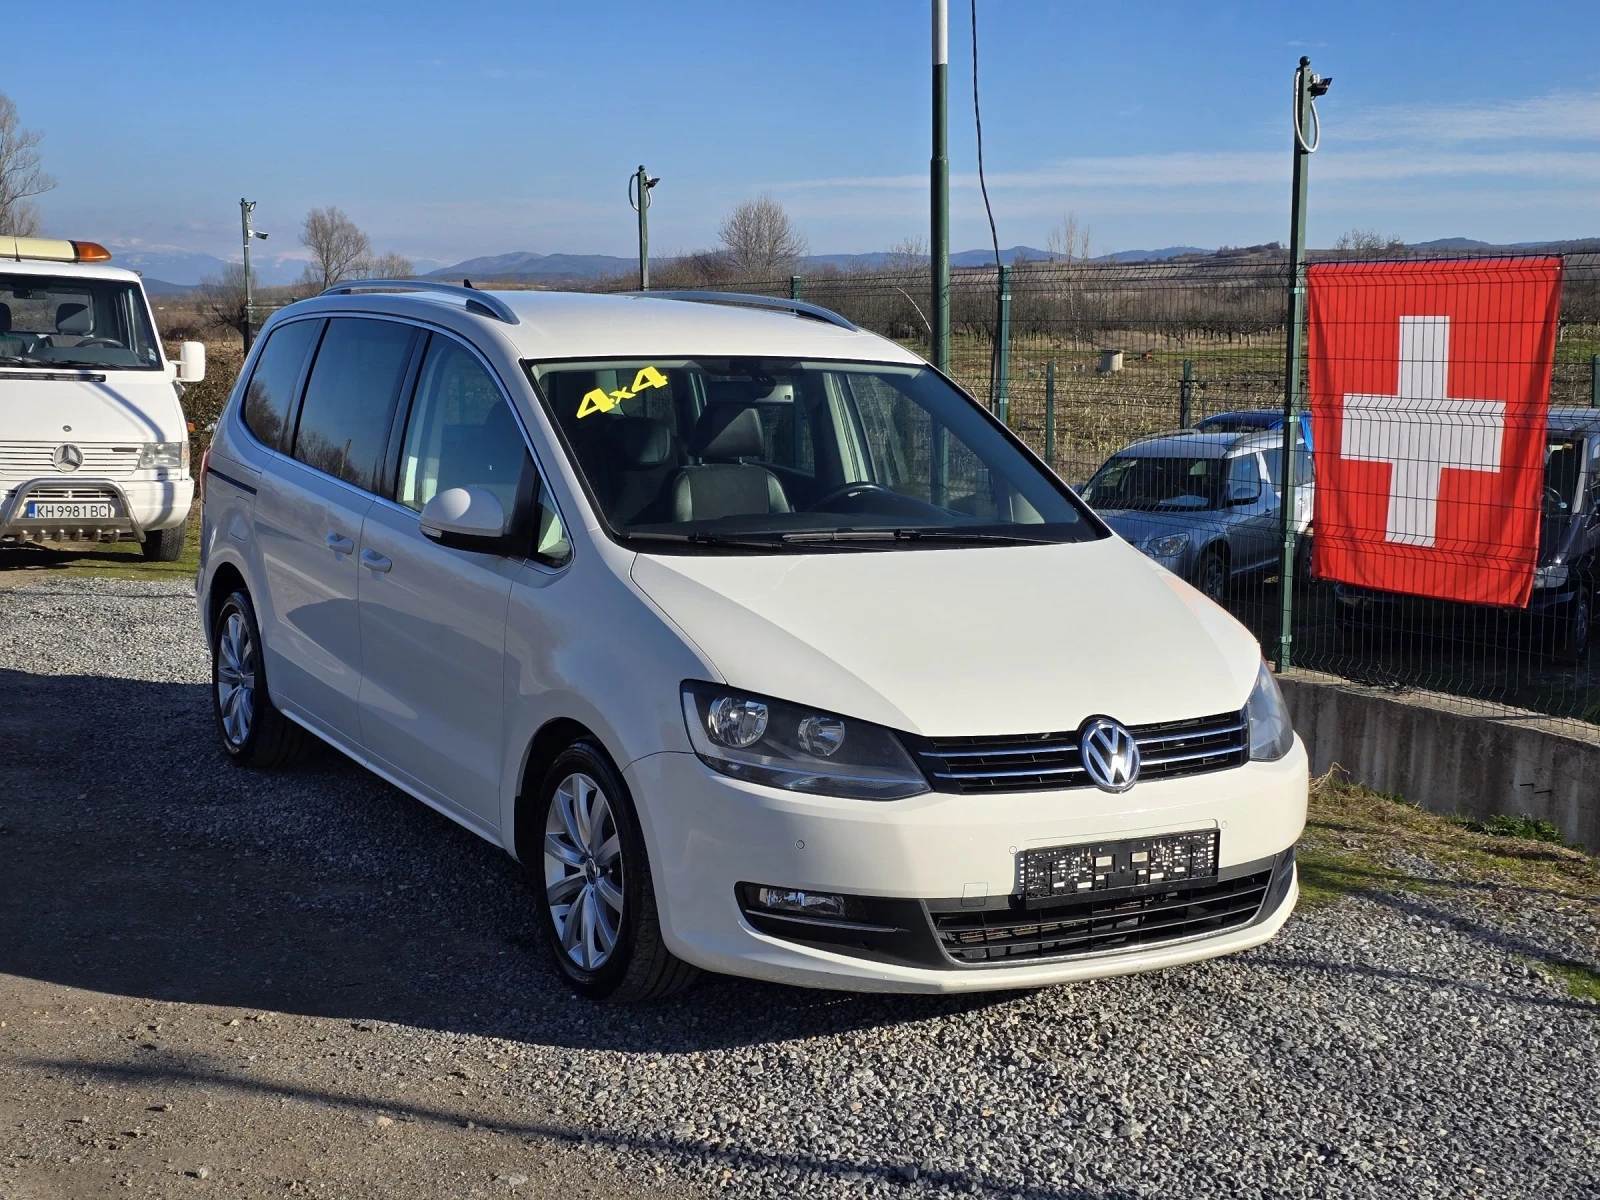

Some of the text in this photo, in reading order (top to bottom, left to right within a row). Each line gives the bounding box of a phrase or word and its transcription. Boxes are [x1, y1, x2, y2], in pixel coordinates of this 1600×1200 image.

[576, 366, 668, 418] 4x4
[37, 505, 54, 518] KH
[57, 505, 87, 518] 9981
[90, 505, 108, 518] BC
